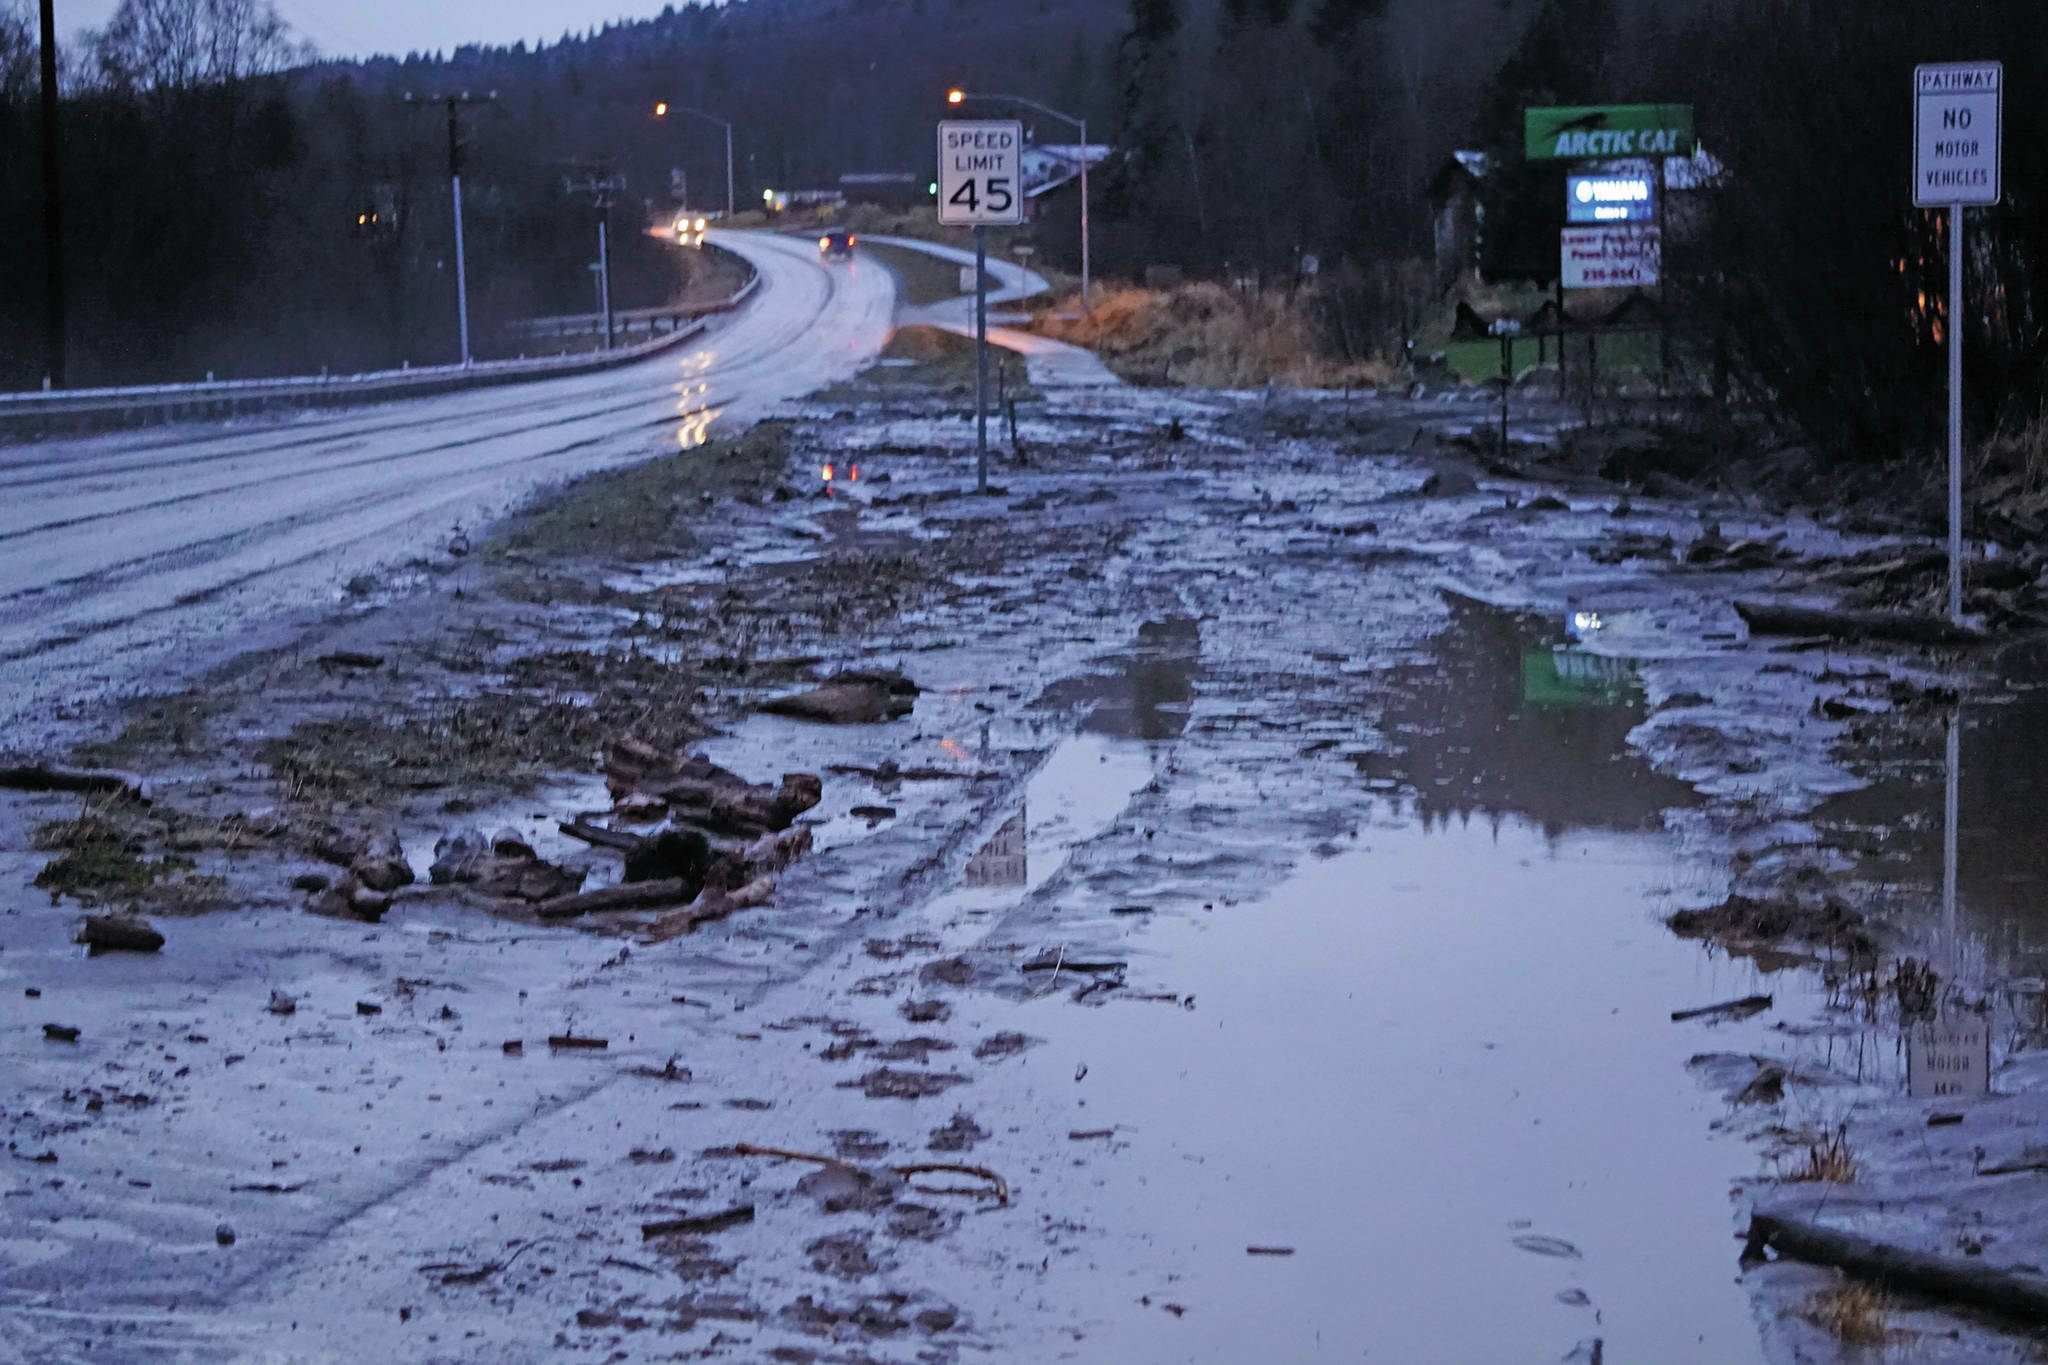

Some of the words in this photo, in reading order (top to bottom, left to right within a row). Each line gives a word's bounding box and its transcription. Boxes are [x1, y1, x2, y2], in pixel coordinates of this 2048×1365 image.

[1922, 71, 1993, 89] PATHWAY
[1943, 108, 1972, 129] NO
[948, 132, 1012, 149] SPEED
[1554, 130, 1635, 156] ARCTIC
[1637, 129, 1678, 152] CAT
[1935, 140, 1979, 158] MOTOR
[955, 155, 1004, 170] LIMIT
[1926, 169, 1987, 187] VEHICLES
[949, 177, 1012, 212] 45
